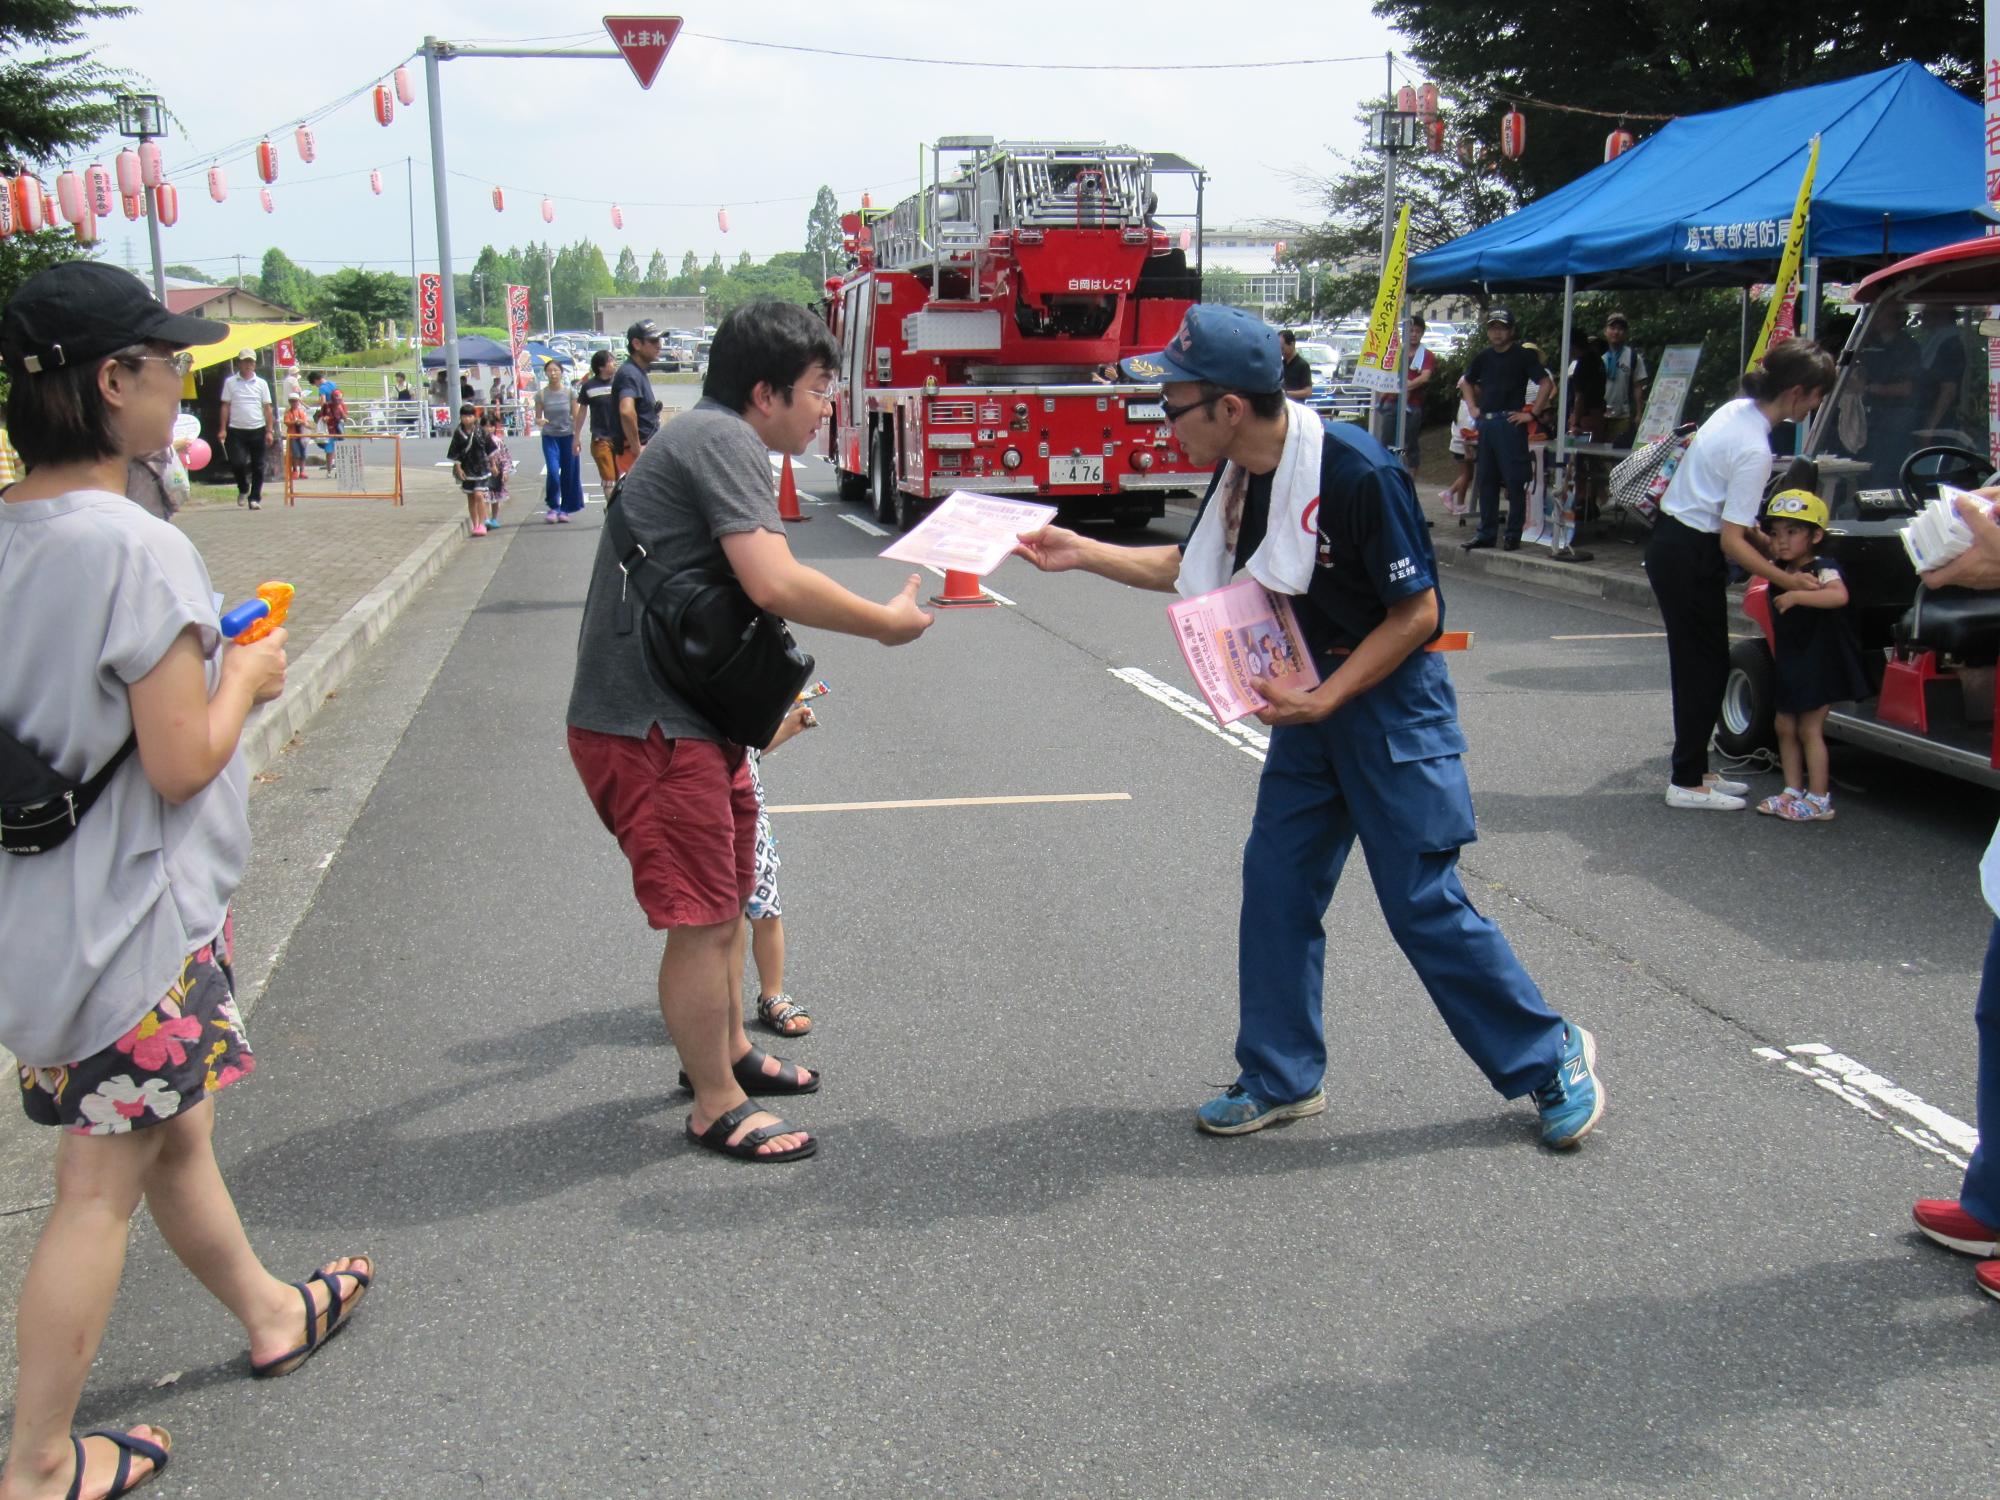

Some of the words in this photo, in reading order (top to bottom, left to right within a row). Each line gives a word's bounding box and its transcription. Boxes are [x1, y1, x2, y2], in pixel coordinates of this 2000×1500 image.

[621, 30, 668, 47] 止まれ
[1684, 218, 1793, 252] 埼玉東部消防局
[1068, 278, 1131, 291] 白岡はしご1
[424, 277, 440, 335] やきとり
